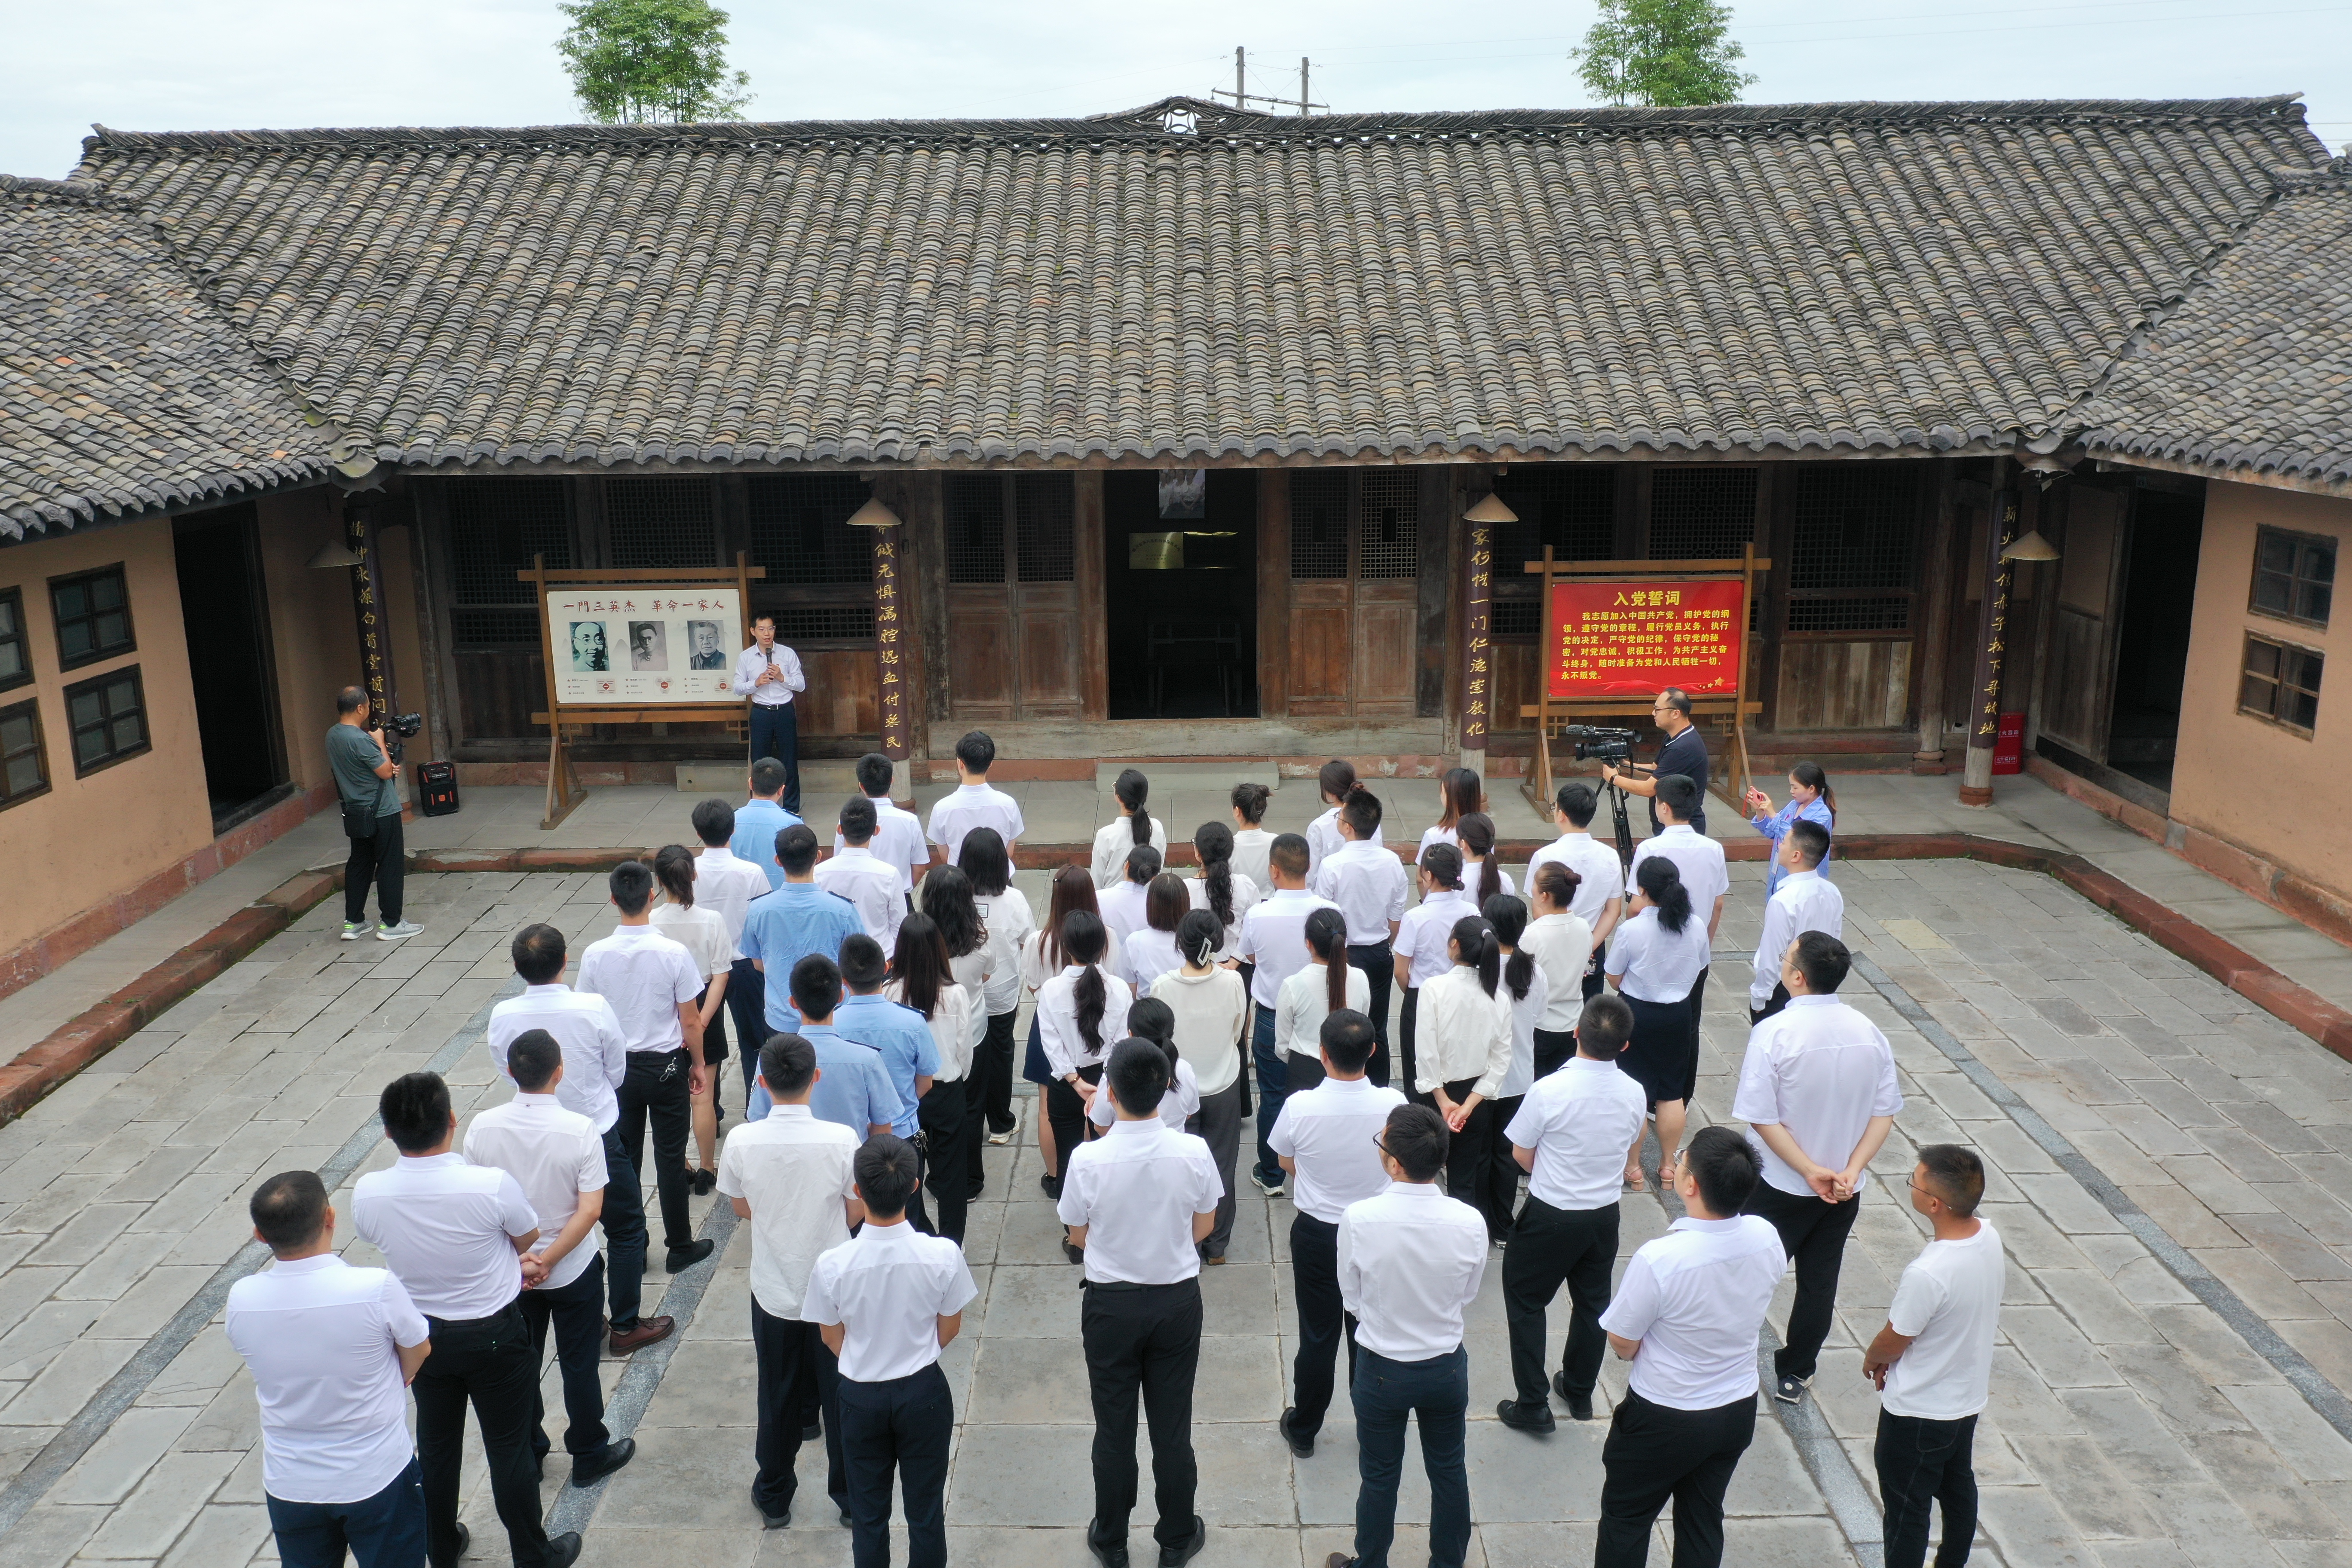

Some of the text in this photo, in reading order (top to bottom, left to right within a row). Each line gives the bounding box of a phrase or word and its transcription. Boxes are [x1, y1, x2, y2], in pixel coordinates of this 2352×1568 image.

[1614, 591, 1680, 606] 入党誓词
[563, 599, 725, 613] 一門三英杰 革命一家人
[1582, 609, 1730, 621] 我志愿加入中国共产党，拥护党的纲
[1563, 622, 1729, 633] 领，遵守党的章程，履行党员义务，执行
[1562, 634, 1718, 645] 党的决定，严守党的纪律，保守党的秘
[1562, 645, 1727, 656] 密，对党忠诚，积极工作，为共产主义奋
[1562, 657, 1722, 668] 斗终身，随时准备为党和人民牺牲一切，
[1561, 671, 1602, 680] 永不叛党。
